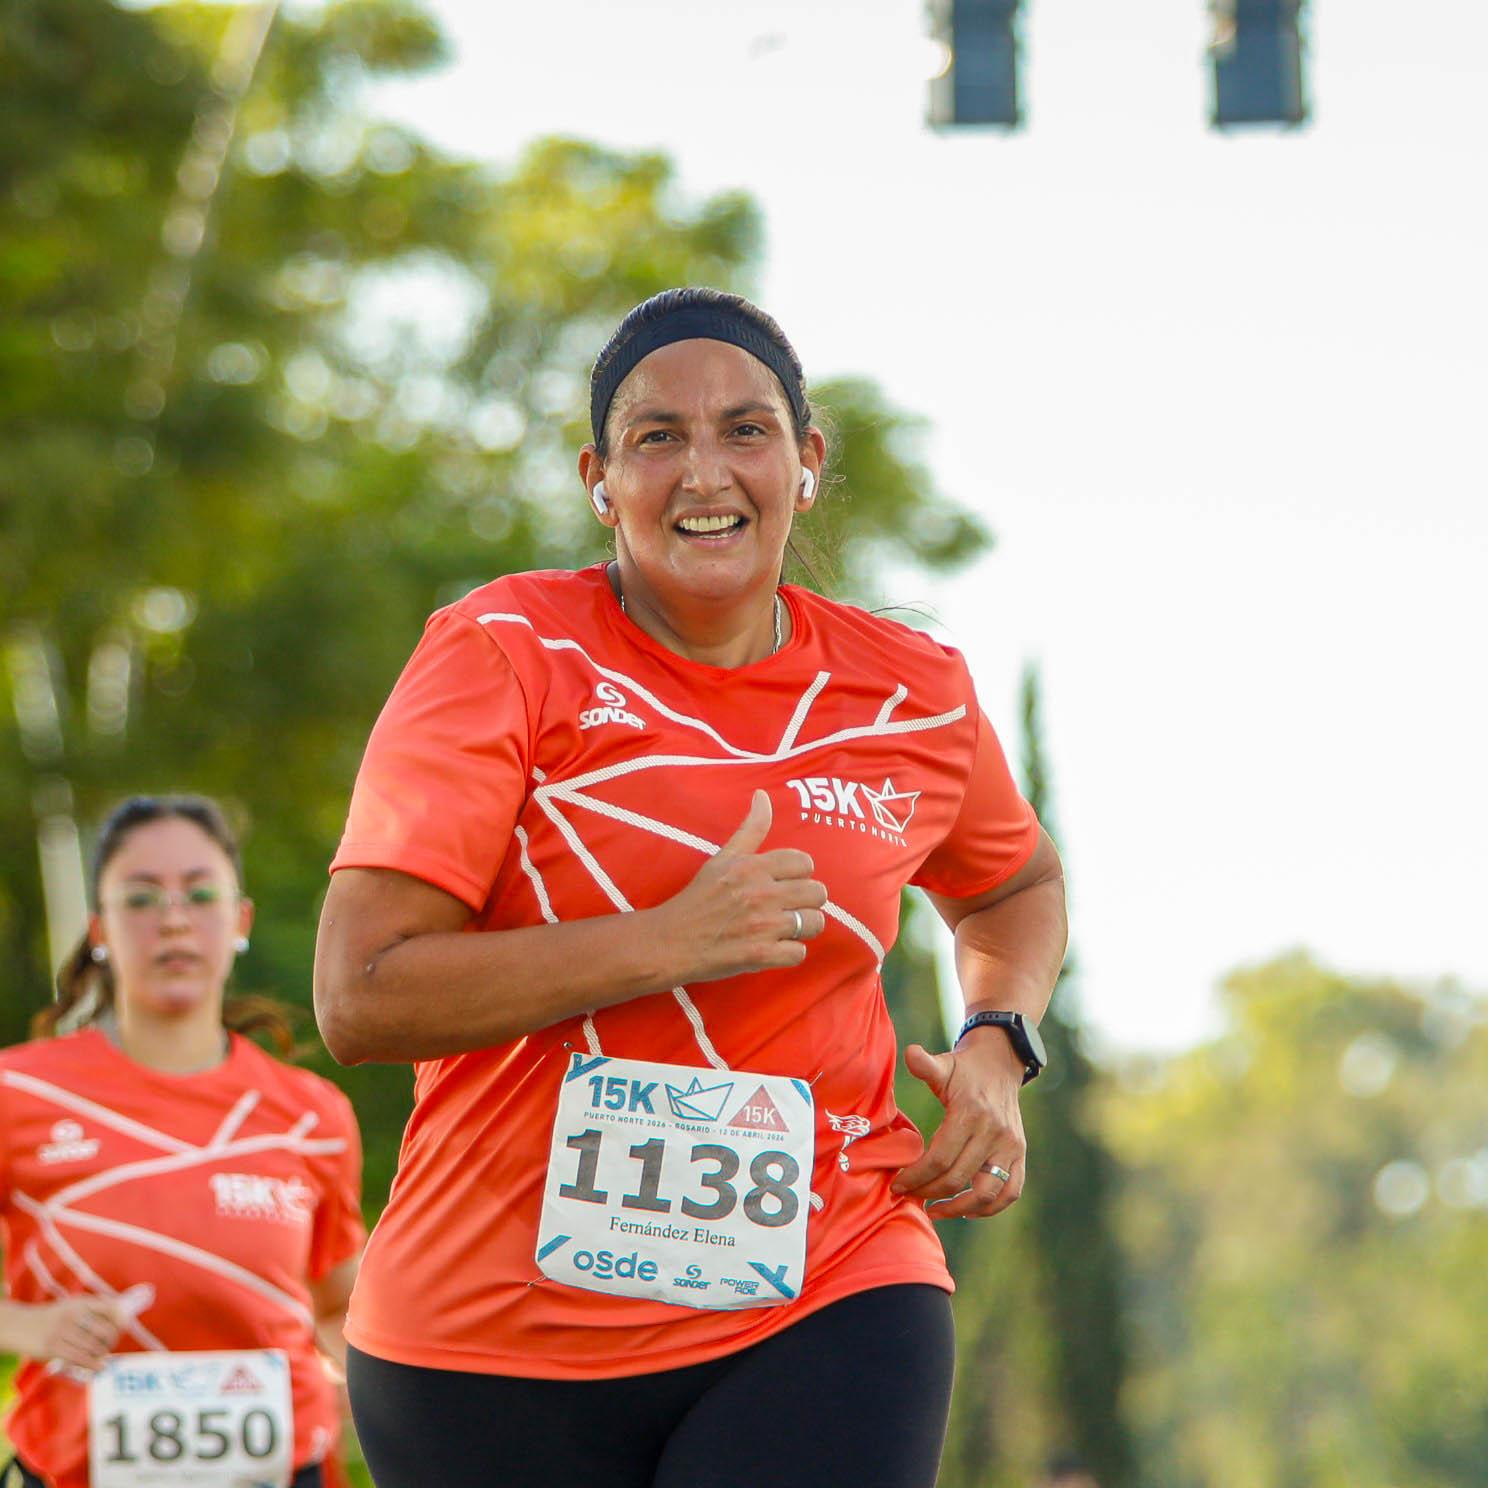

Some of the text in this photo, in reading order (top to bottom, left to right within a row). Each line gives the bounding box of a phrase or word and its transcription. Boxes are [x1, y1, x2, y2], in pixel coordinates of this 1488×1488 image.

[785, 777, 866, 819] 15K
[587, 1074, 660, 1115] 15K
[583, 1111, 616, 1123] PUERTO
[617, 1115, 645, 1126] NORTE
[647, 1119, 666, 1129] 2026
[674, 1122, 711, 1134] ROSARIO
[730, 1129, 740, 1137] DE
[742, 1130, 765, 1139] ABRIL
[744, 1104, 776, 1126] 15K
[559, 1128, 800, 1228] 1138
[609, 1216, 736, 1248] Fernández Elena
[573, 1249, 659, 1282] osde
[720, 1277, 760, 1289] POWER
[734, 1286, 758, 1296] ADE
[105, 1409, 277, 1462] 1850
